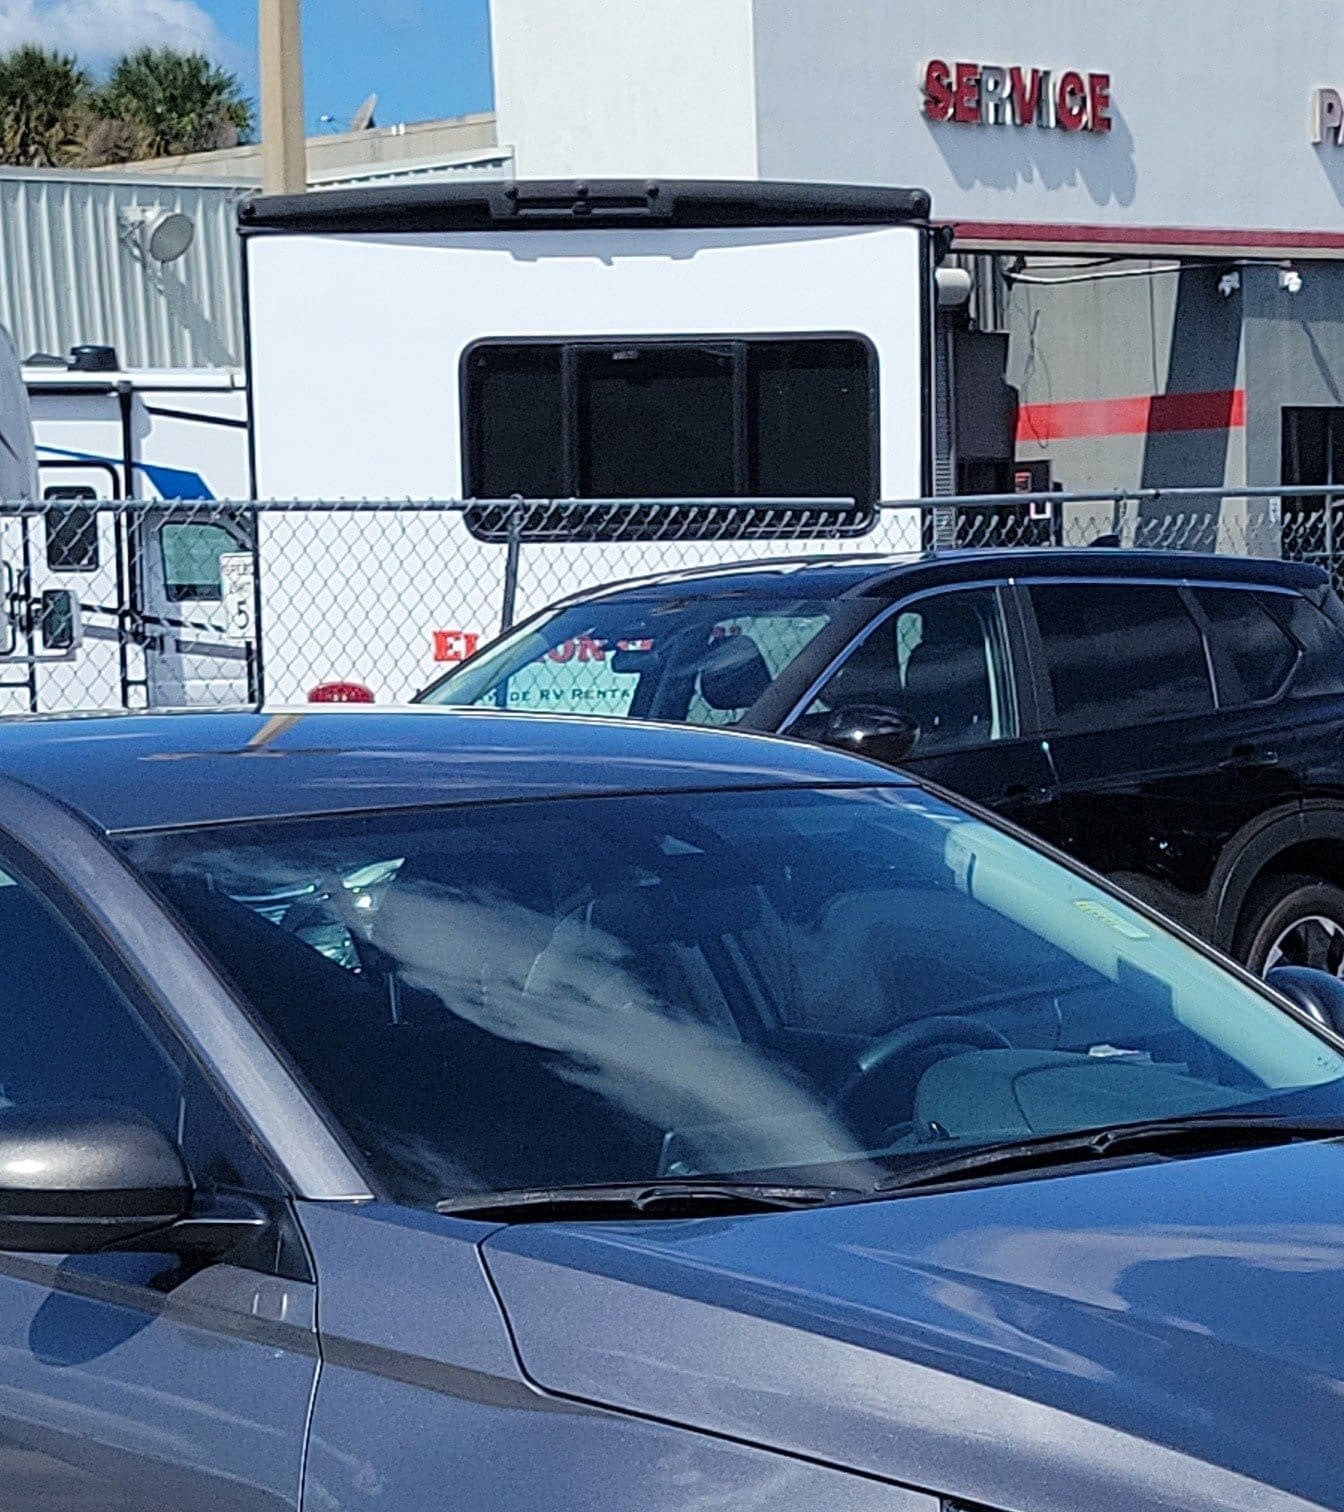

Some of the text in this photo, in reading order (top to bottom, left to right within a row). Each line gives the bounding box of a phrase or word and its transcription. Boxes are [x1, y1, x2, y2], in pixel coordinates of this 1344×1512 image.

[923, 59, 1113, 132] SERVICE
[232, 600, 249, 629] 5
[539, 689, 565, 701] RV
[571, 688, 631, 701] RENTA
